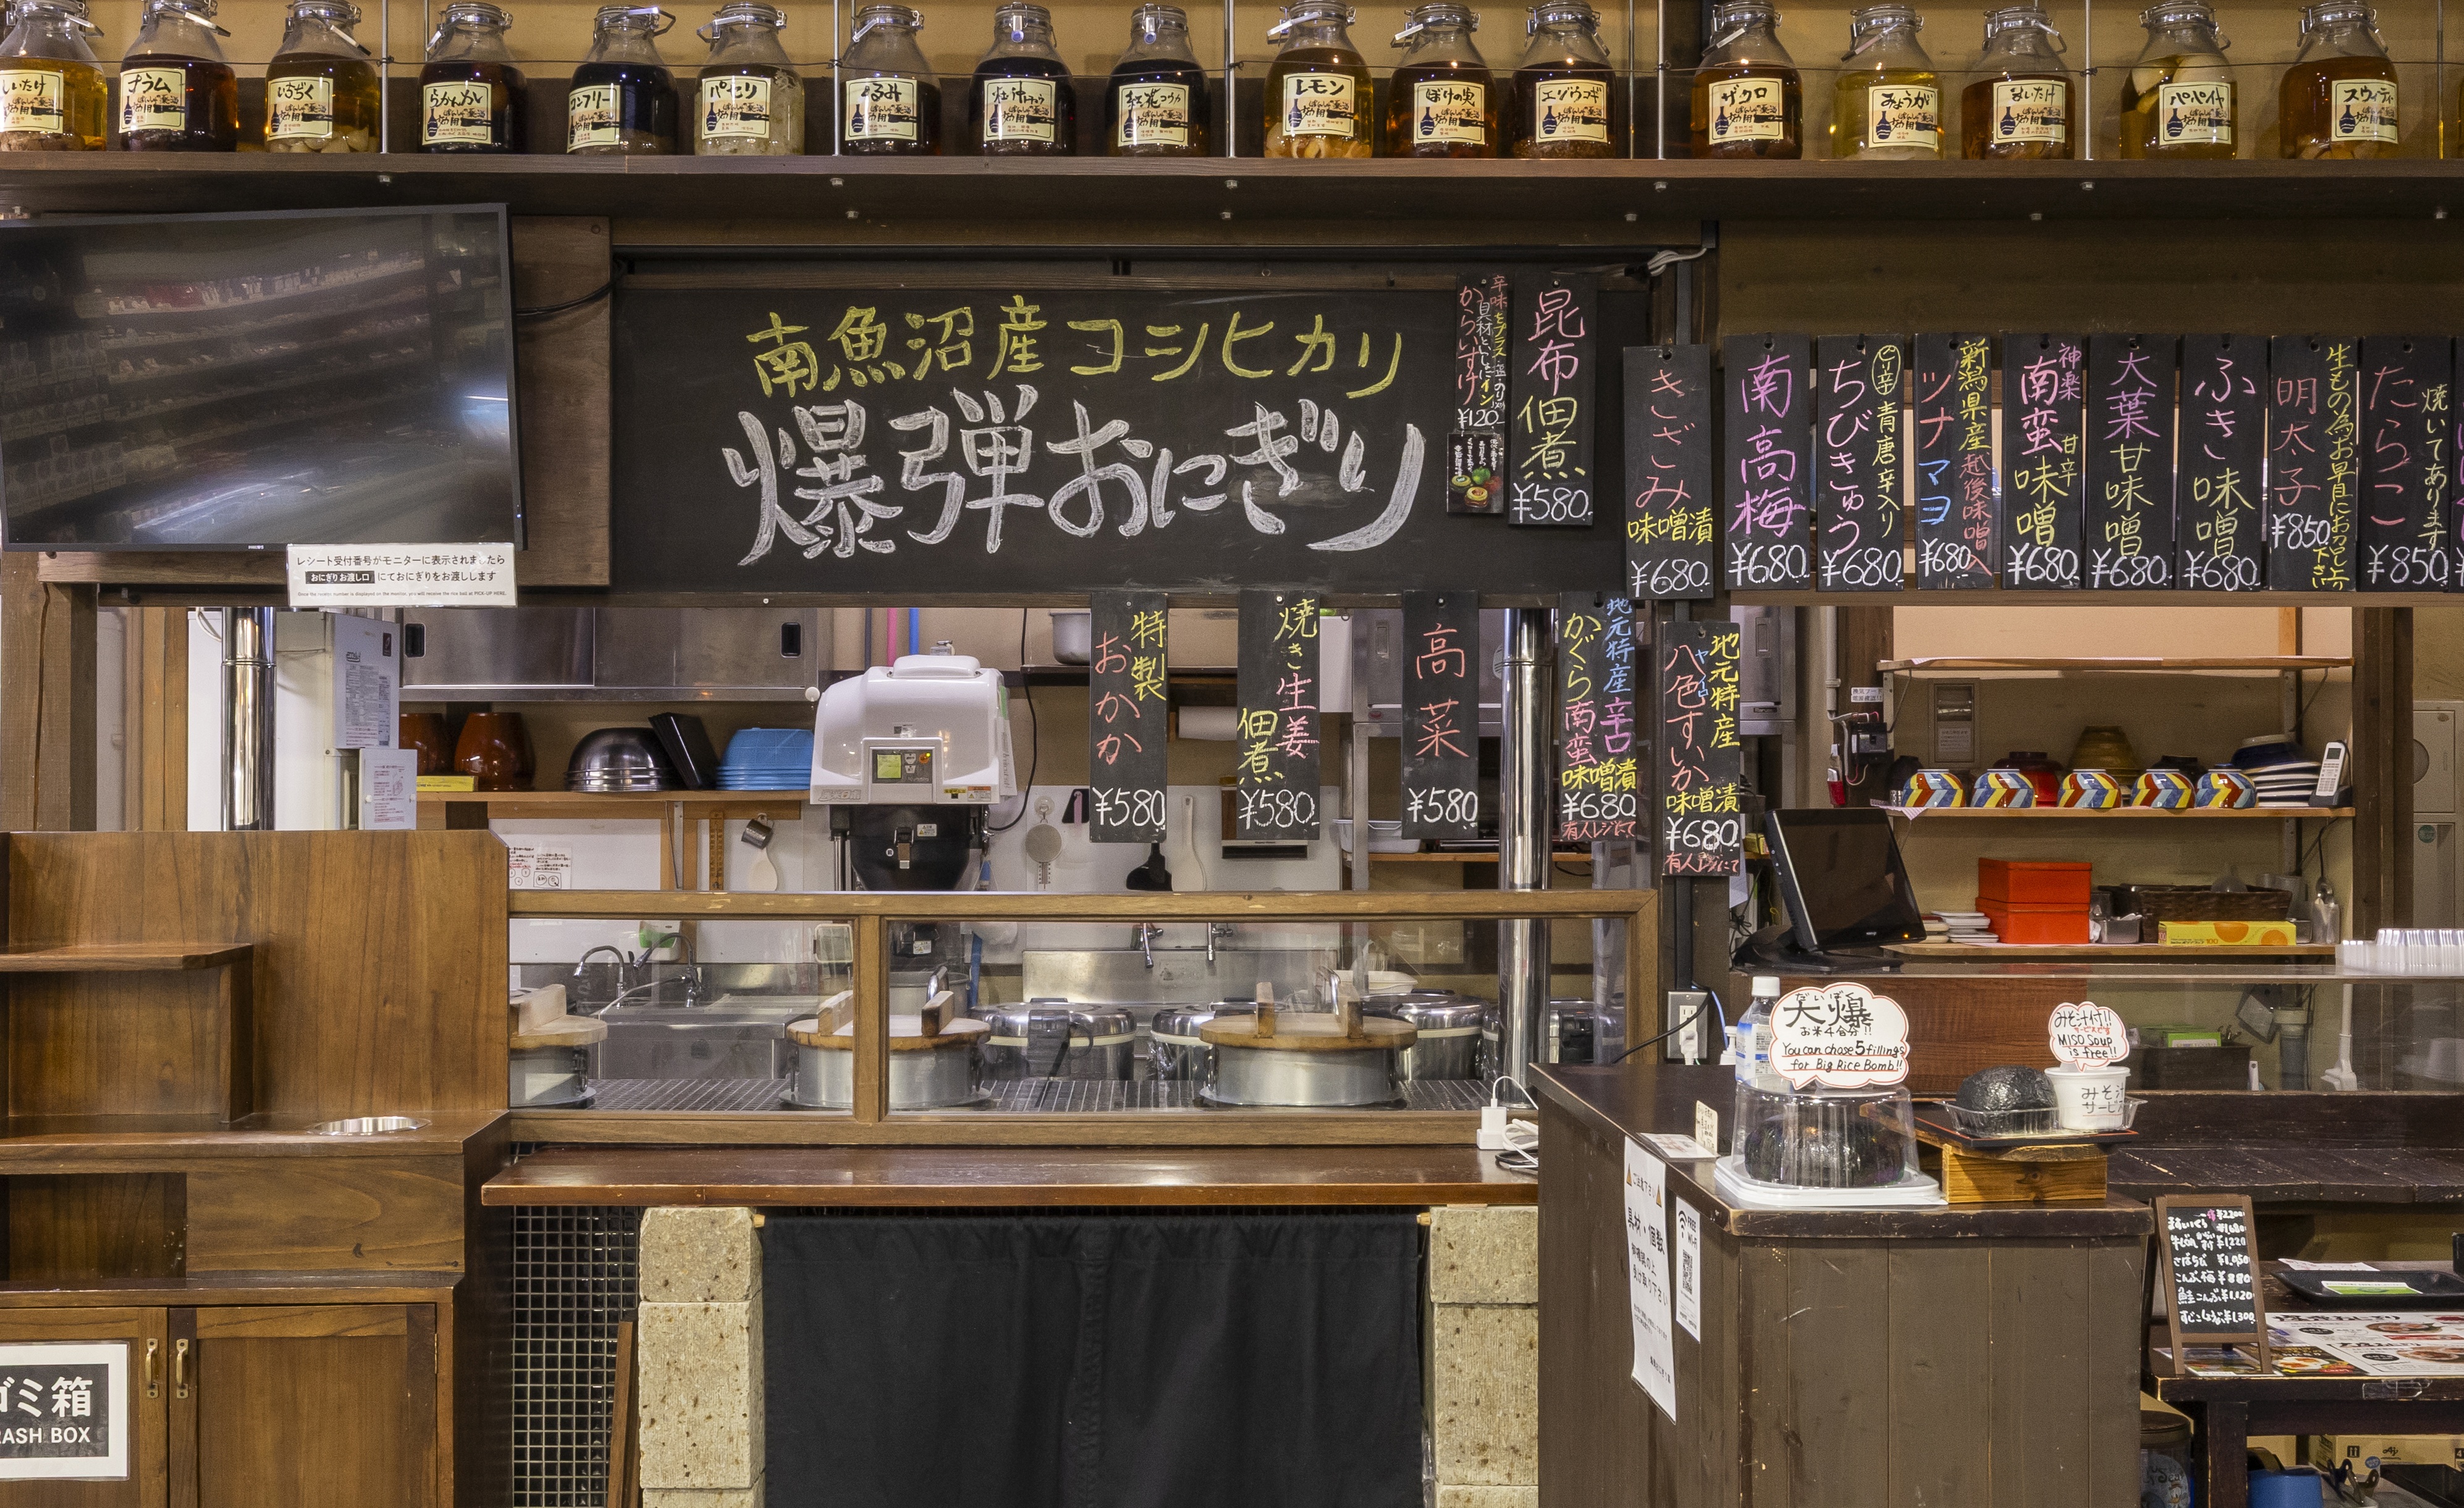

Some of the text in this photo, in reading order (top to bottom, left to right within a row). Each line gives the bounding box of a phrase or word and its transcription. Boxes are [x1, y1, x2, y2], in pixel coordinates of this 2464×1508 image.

[2, 75, 46, 96] しいたけ
[710, 80, 757, 99] パセリ
[1296, 79, 1344, 95] レモン
[1721, 85, 1767, 104] ザクロ
[1881, 90, 1931, 109] みょうが
[2170, 87, 2224, 109] パパイヤ
[745, 295, 1402, 397] 南魚沼産コシヒカリ
[1517, 289, 1586, 481] 昆布佃煮
[2058, 342, 2082, 401] 神楽
[722, 384, 1426, 566] 爆弾おにぎり
[1635, 369, 1695, 510] きざみ
[1728, 355, 1807, 539] 南高梅
[1826, 359, 1873, 555] ちびきゅう
[1873, 401, 1901, 539] 青唐辛入り
[1918, 371, 1954, 526] ツナマヨ
[2103, 352, 2161, 557] 大葉甘味噌
[2193, 357, 2256, 557] ふき味噌
[2272, 377, 2321, 506] 明太子
[2369, 366, 2418, 526] たらこ
[2417, 384, 2448, 551] 焼いてあります
[1627, 507, 1713, 545] 味噌漬
[1094, 630, 1142, 765] おかか
[1130, 610, 1167, 701] 特製
[1273, 599, 1320, 759] 焼き生姜
[1415, 622, 1470, 758] 高菜
[1708, 632, 1740, 749] 地元特産
[1236, 707, 1285, 785] 佃煮
[1783, 996, 1874, 1028] 大爆
[1795, 990, 1854, 1001] だいばく
[2057, 1034, 2085, 1046] MISO
[1783, 1040, 1905, 1058] You can chose 5 fillings
[1791, 1058, 1810, 1071] for
[1816, 1058, 1833, 1072] Big
[1837, 1059, 1860, 1071] Rice
[2069, 1047, 2078, 1056] is
[2081, 1082, 2124, 1100] みそ汁
[0, 1427, 90, 1444] ASH BOX
